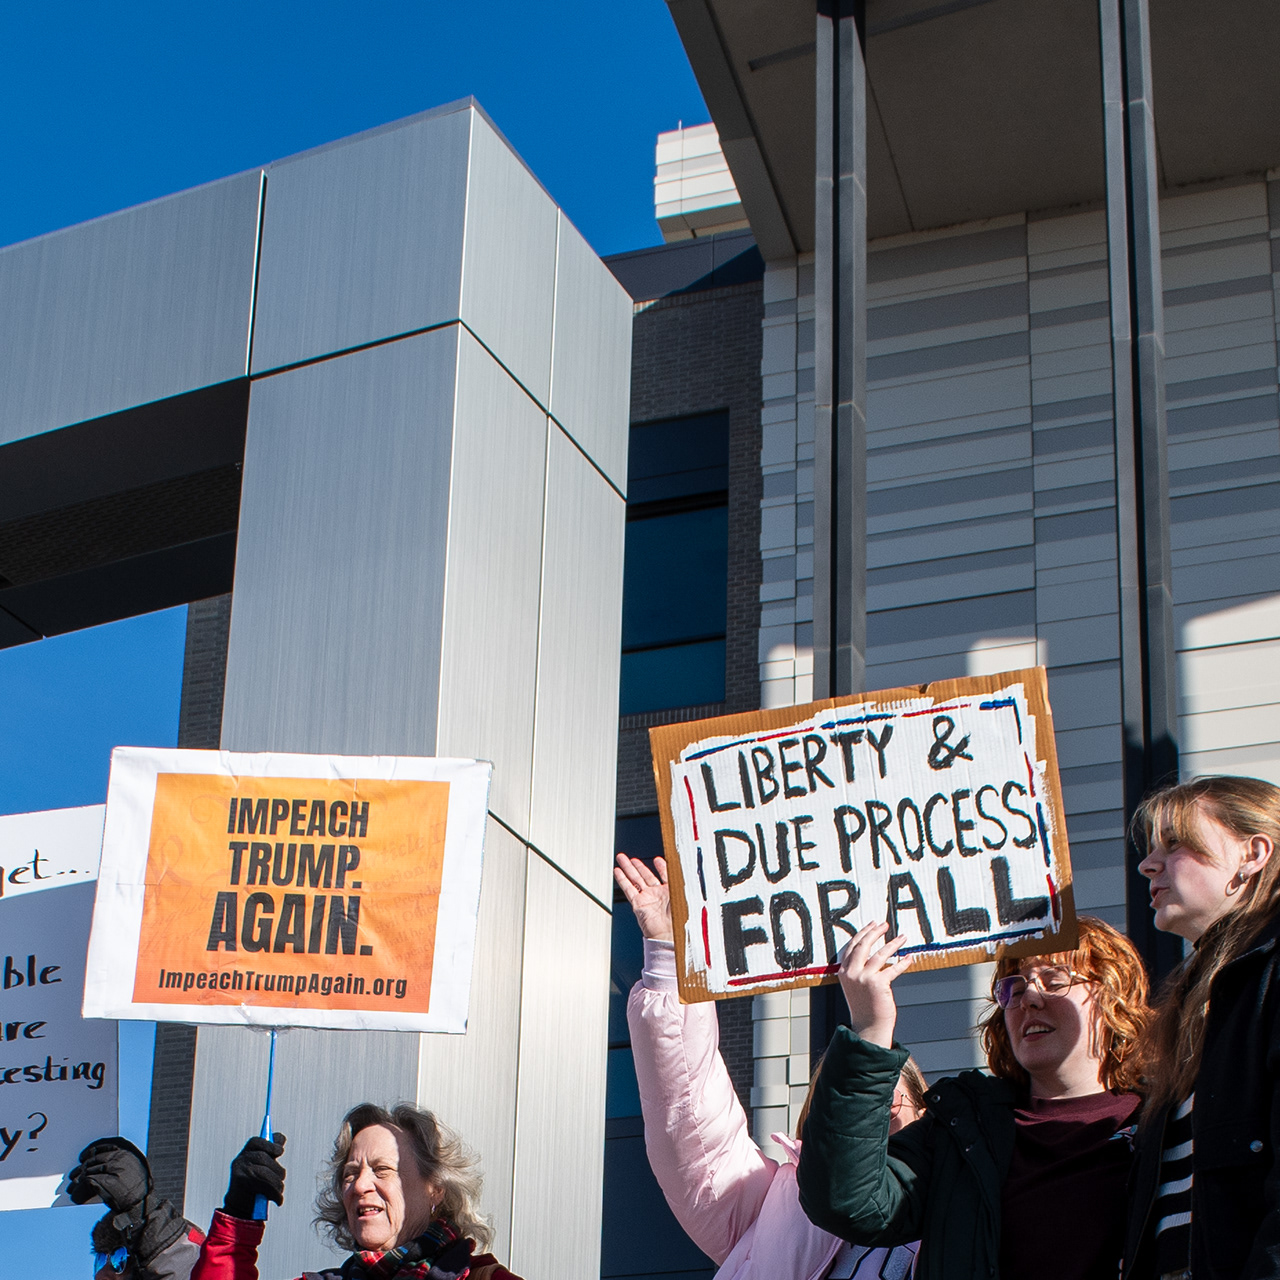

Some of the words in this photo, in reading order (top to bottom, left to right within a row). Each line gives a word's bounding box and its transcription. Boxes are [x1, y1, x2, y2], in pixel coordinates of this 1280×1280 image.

[700, 724, 894, 813] LIBERTY
[927, 714, 974, 770] &
[227, 797, 370, 838] IMPEACH
[714, 815, 820, 890] DUE
[833, 781, 1038, 874] PROCESS
[228, 841, 362, 889] TRUMP.
[206, 891, 374, 956] AGAIN.
[720, 880, 860, 977] FOR
[885, 856, 1050, 947] ALL
[158, 968, 408, 999] ImpeachTrumpAgain.org
